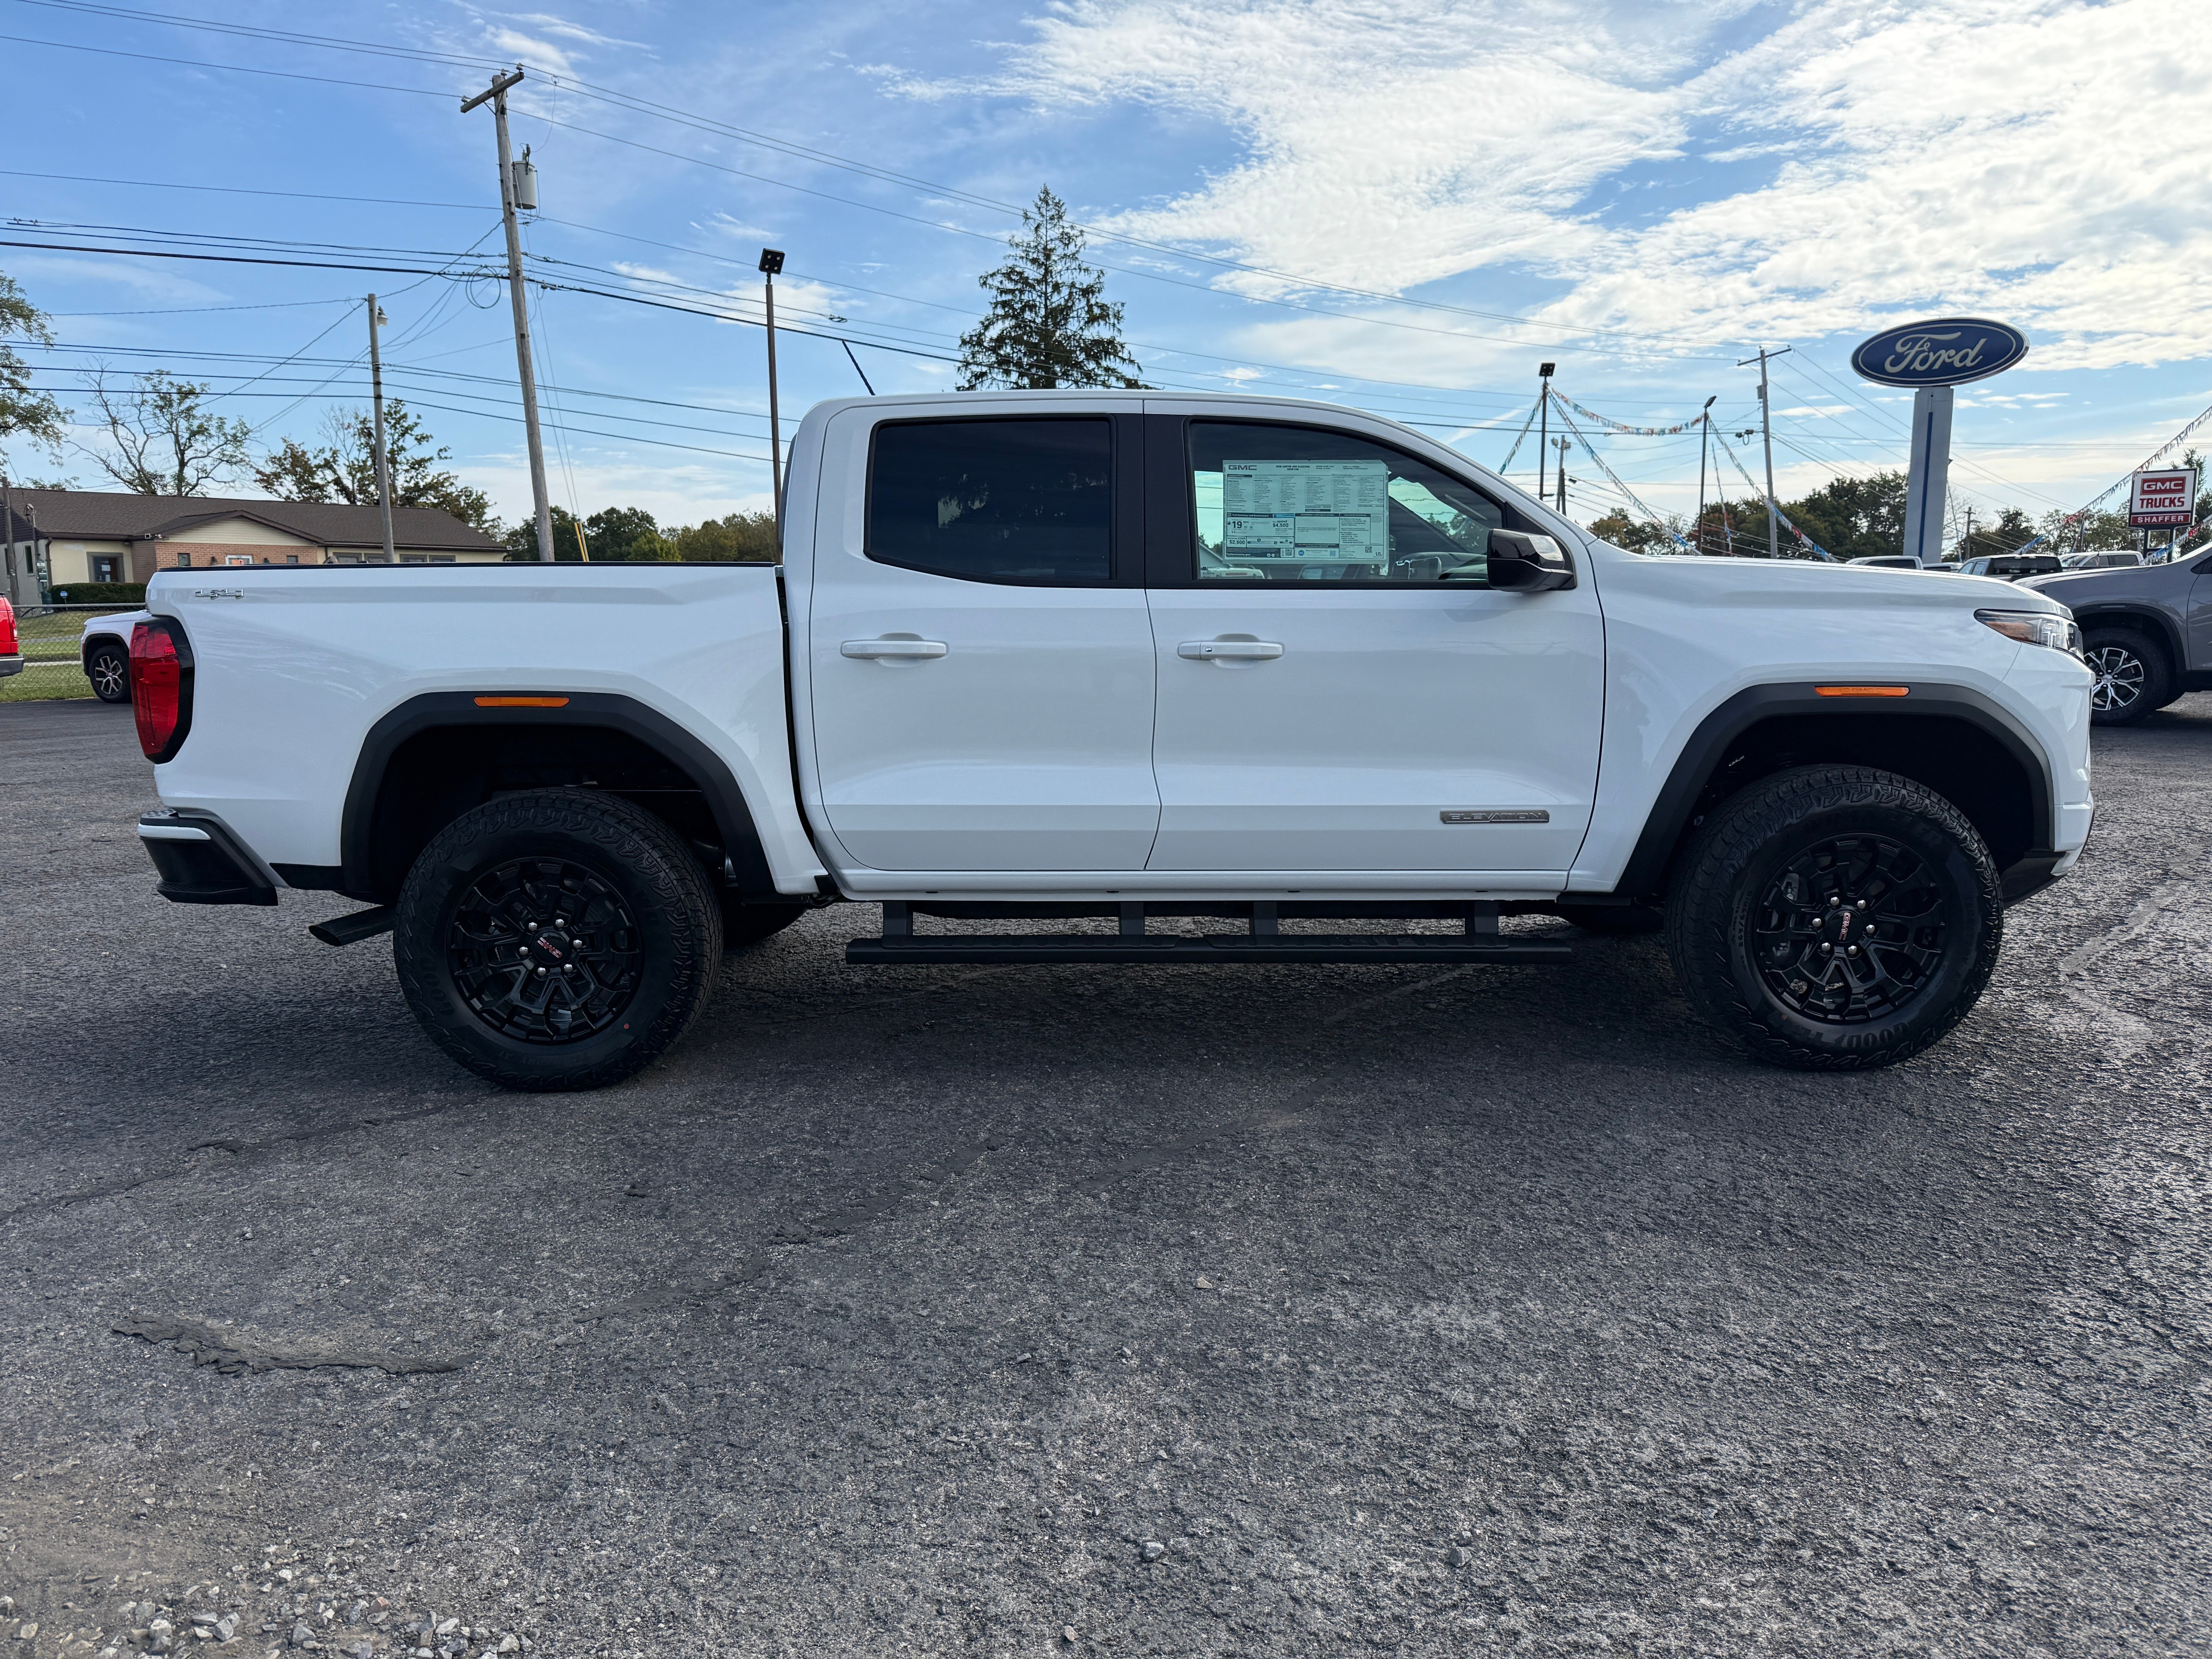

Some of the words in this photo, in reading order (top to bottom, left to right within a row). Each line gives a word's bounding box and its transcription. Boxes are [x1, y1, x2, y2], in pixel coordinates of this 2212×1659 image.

[1884, 331, 1987, 373] Ford
[2143, 481, 2183, 490] GMC
[2139, 496, 2185, 508] TRUCKS
[1839, 912, 1851, 940] GMC
[537, 937, 562, 958] GMC
